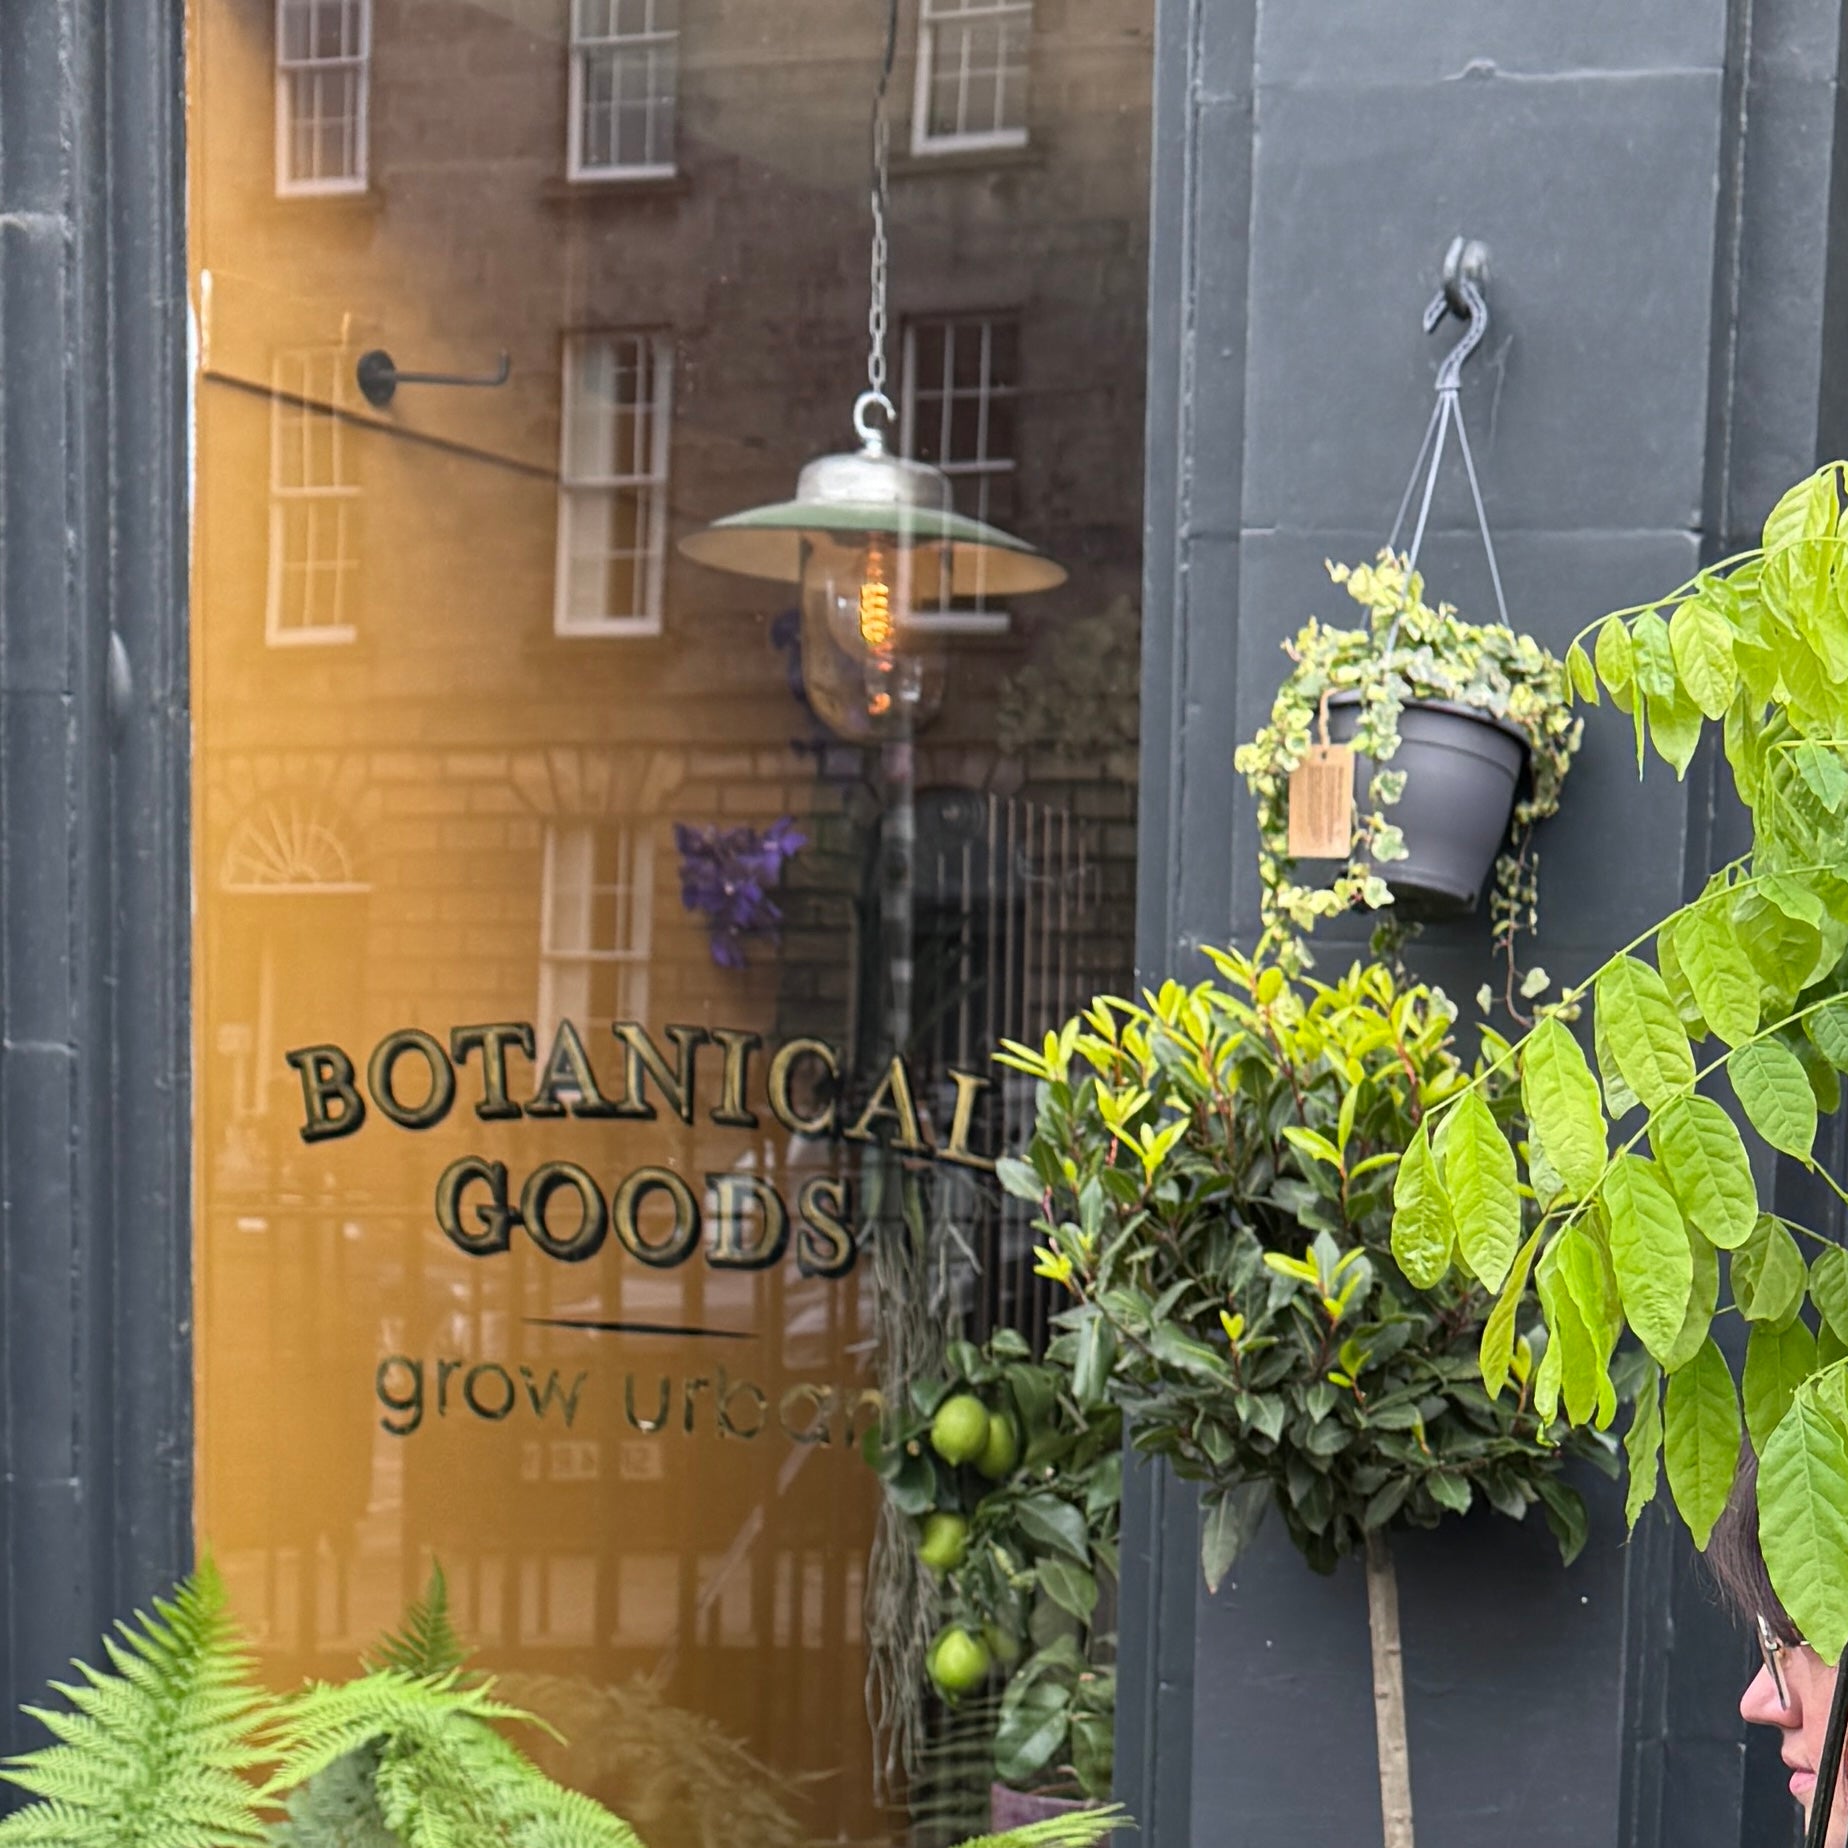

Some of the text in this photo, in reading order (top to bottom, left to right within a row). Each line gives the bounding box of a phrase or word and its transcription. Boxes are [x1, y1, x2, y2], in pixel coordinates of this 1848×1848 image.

[286, 1018, 998, 1172] BOTANICAL
[435, 1156, 858, 1279] GOODS
[376, 1353, 588, 1436] grow
